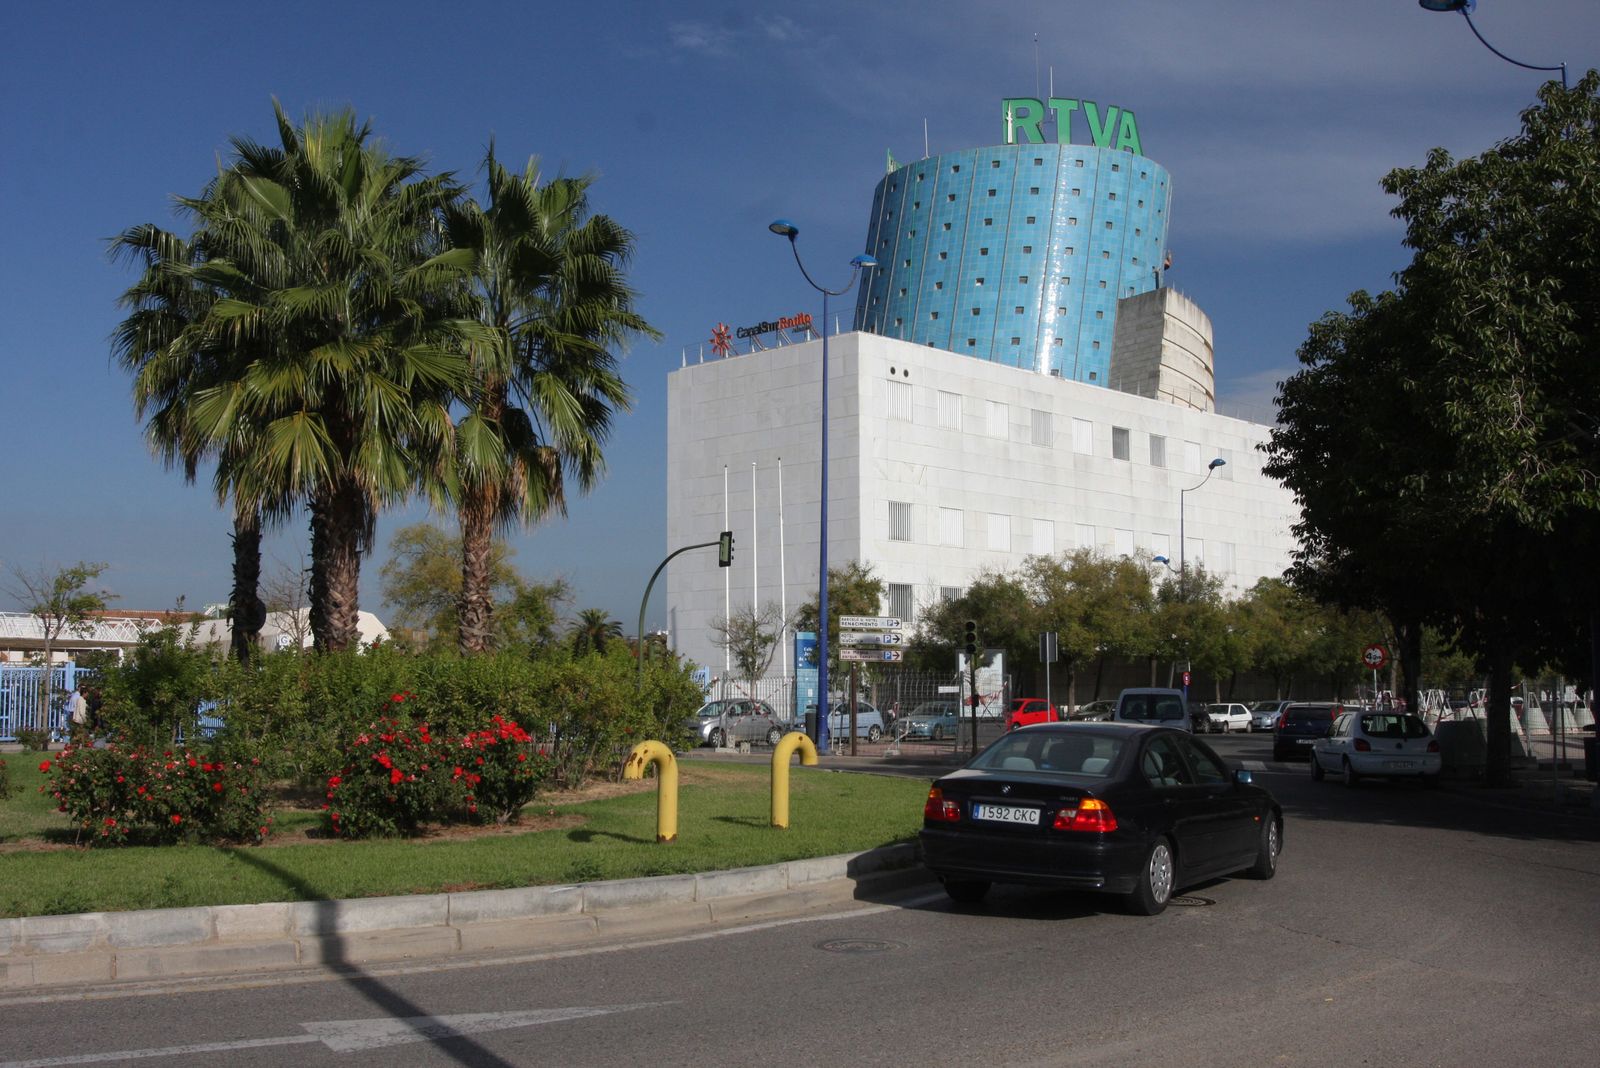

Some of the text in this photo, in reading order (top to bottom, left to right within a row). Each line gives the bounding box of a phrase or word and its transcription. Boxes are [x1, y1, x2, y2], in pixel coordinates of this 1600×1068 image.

[1002, 97, 1144, 156] RTVA
[280, 635, 288, 644] G
[982, 806, 1037, 822] 1592 CKC
